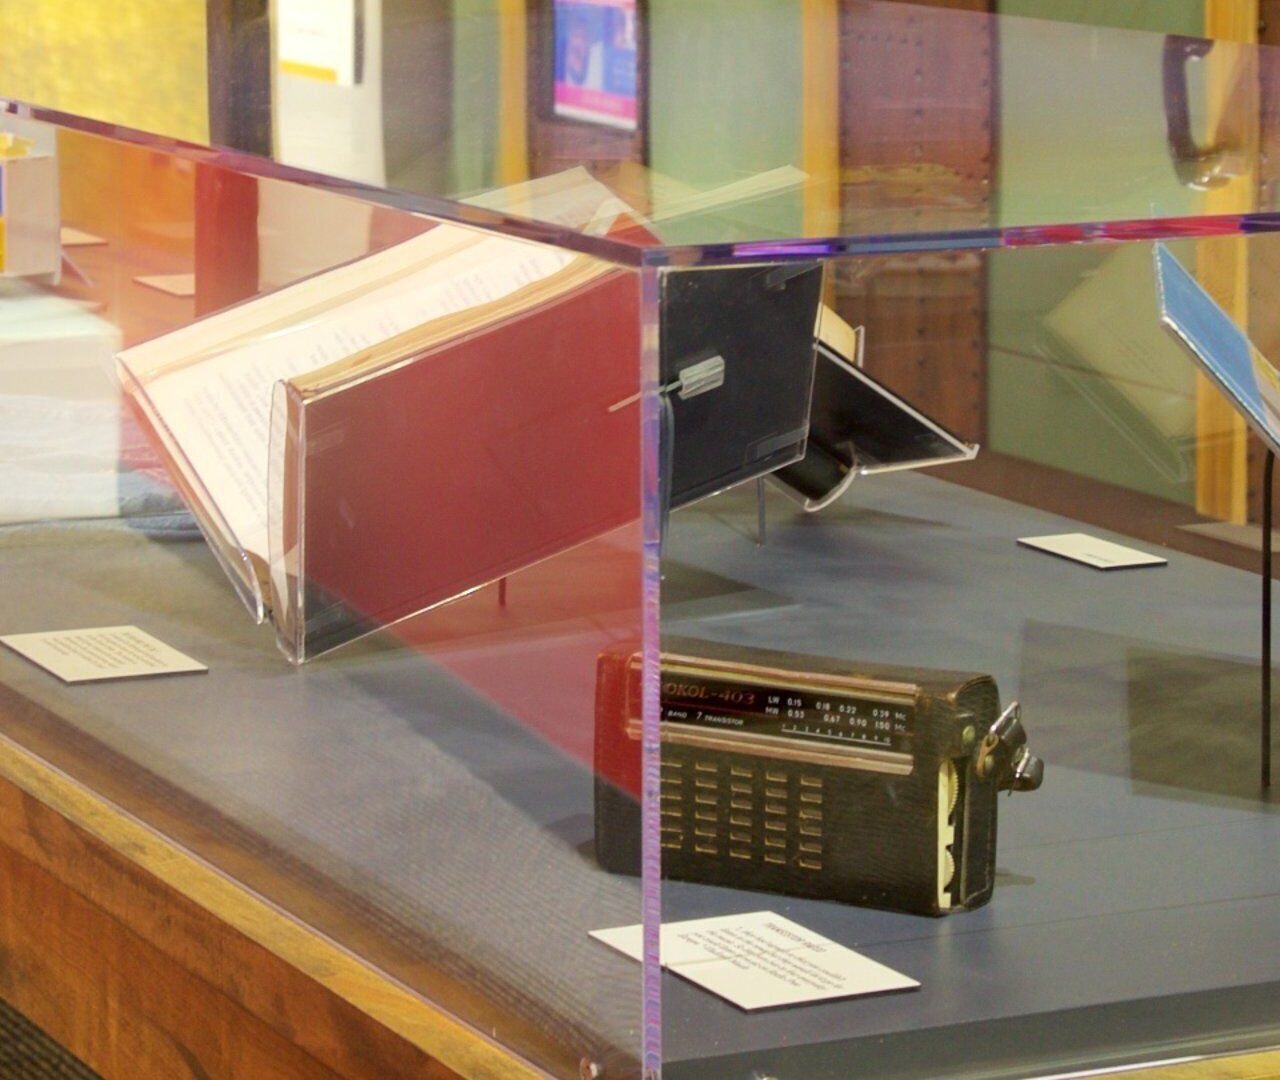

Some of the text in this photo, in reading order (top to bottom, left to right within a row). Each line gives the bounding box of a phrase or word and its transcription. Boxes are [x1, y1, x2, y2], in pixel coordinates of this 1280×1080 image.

[661, 681, 755, 705] OKOL-403
[765, 706, 779, 716] MW
[768, 695, 781, 705] LW
[787, 697, 802, 707] 0.15
[839, 704, 857, 714] 0.22
